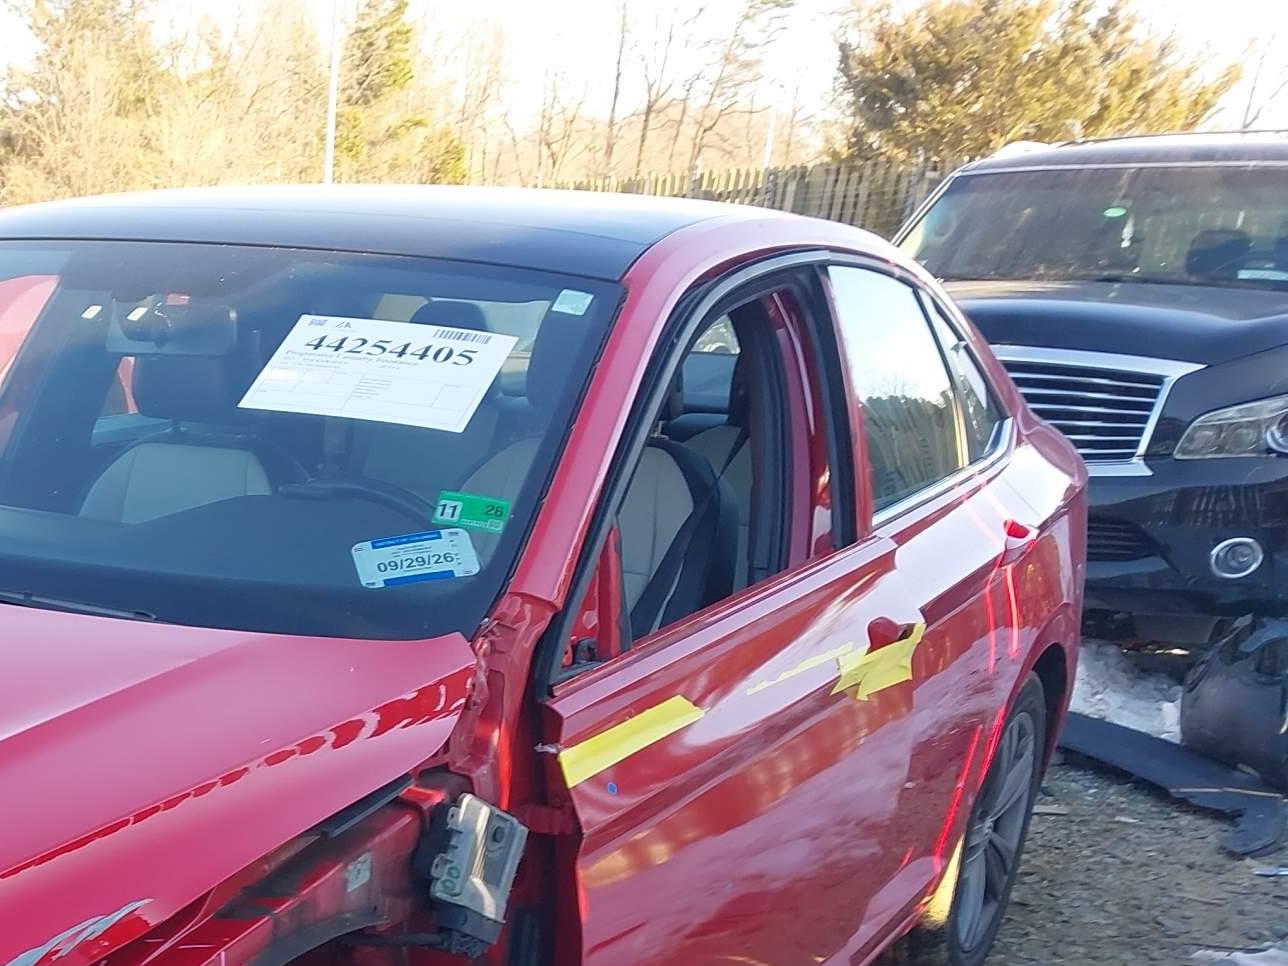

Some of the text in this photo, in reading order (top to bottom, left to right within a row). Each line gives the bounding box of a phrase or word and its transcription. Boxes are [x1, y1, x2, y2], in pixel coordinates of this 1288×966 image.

[305, 334, 480, 366] 44254405
[440, 503, 504, 519] 11 26
[376, 551, 455, 573] 09/29/26
